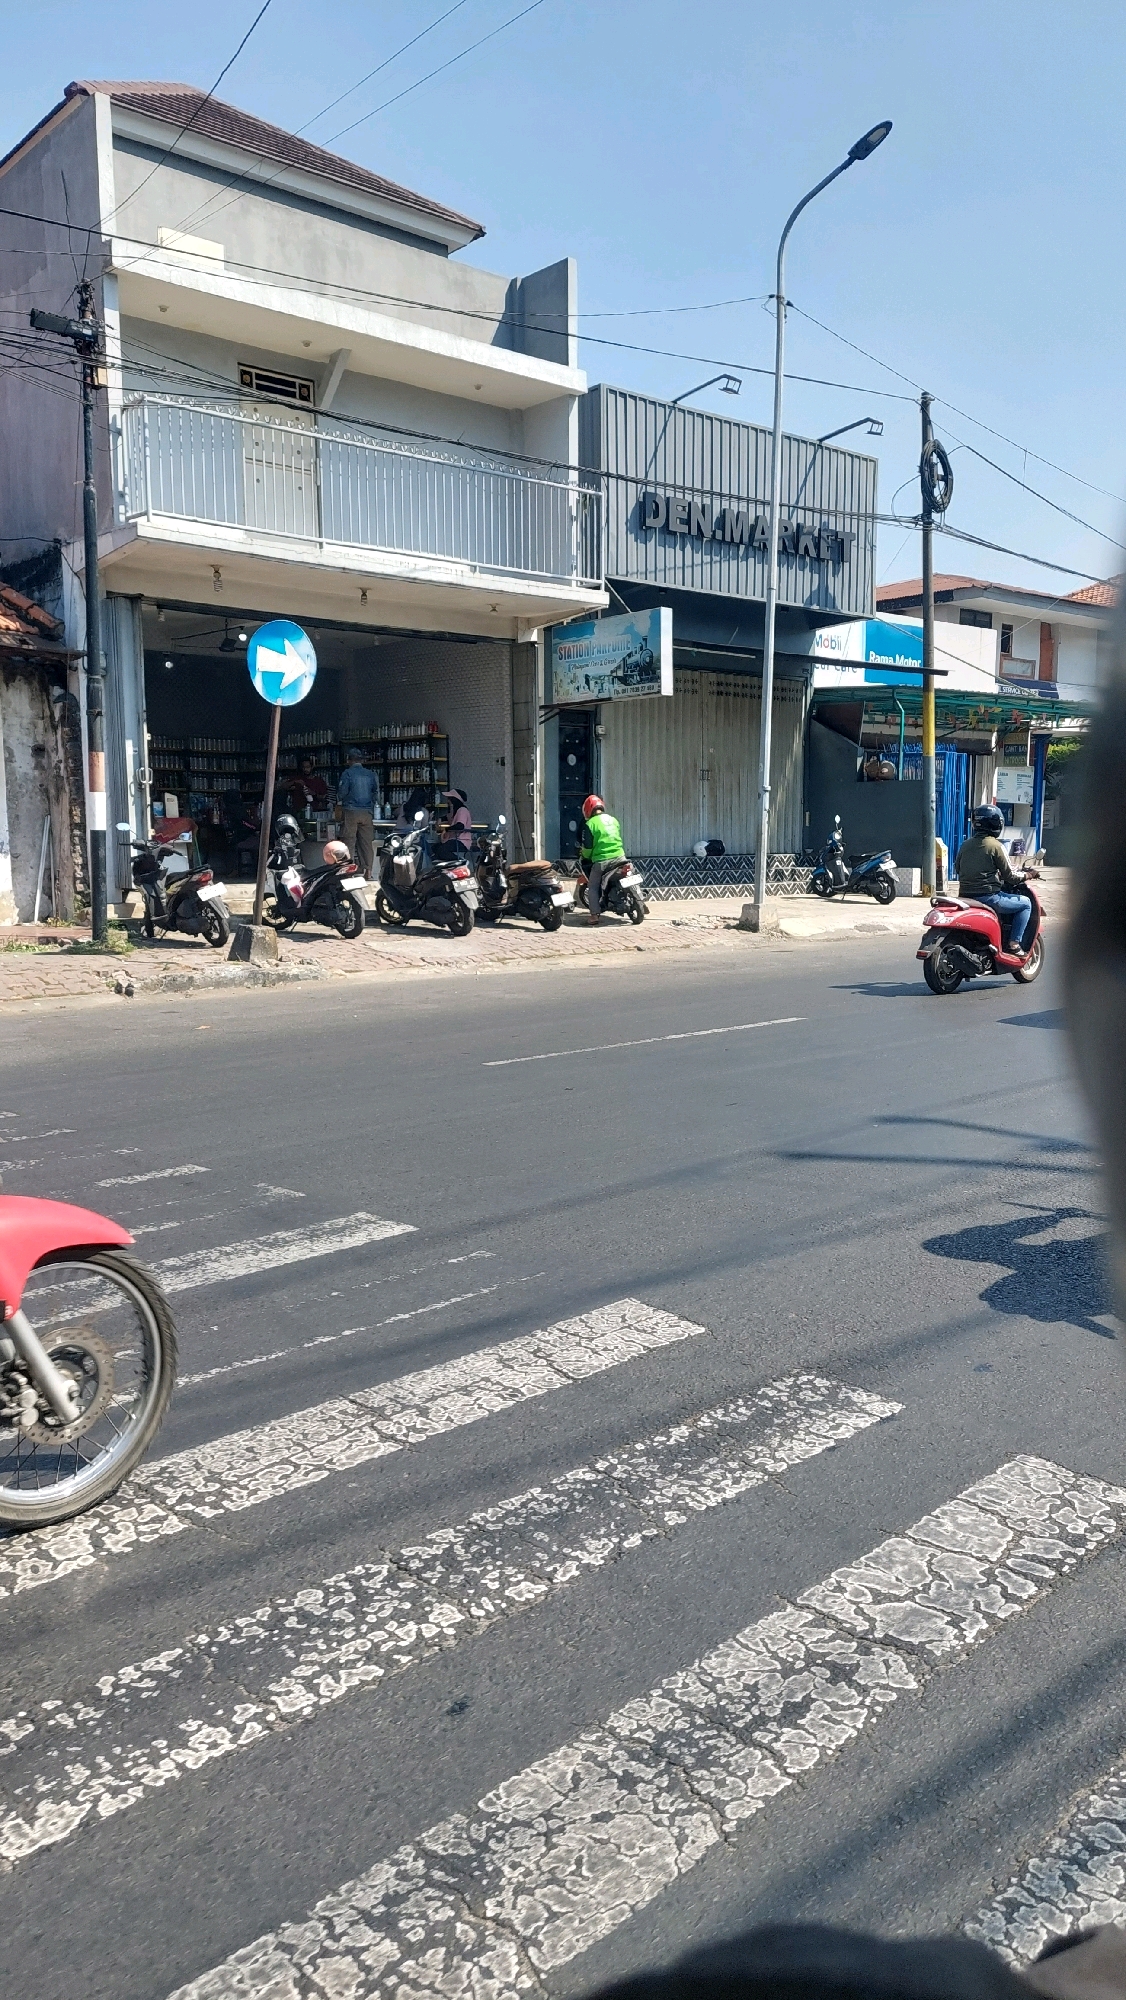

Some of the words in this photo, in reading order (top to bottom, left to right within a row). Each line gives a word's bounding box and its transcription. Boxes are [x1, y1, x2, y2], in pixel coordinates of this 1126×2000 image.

[643, 491, 856, 563] DEN.MARKET
[558, 641, 590, 661] STATION
[869, 650, 894, 664] Rama
[895, 653, 922, 668] Motor
